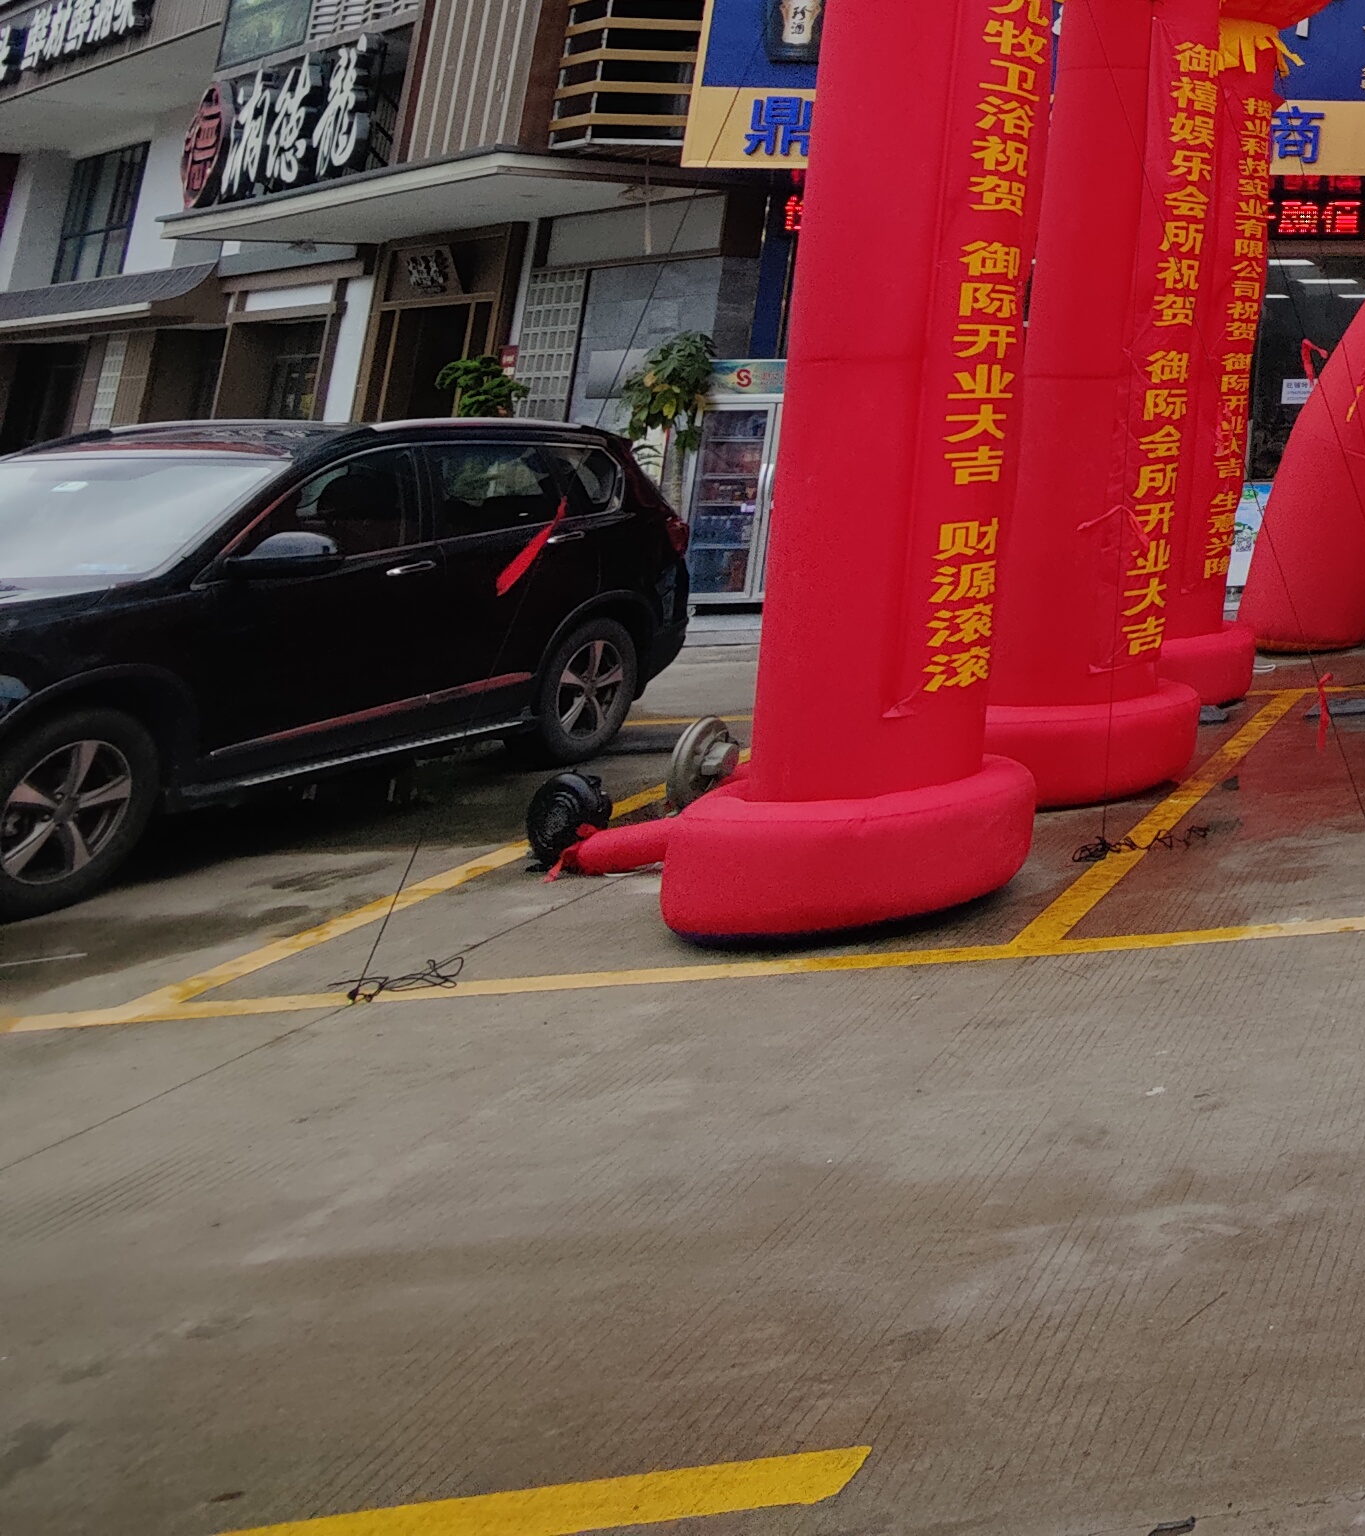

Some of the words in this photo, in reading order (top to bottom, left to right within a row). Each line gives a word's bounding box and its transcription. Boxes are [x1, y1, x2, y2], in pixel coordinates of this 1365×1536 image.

[942, 239, 1021, 487] 御际开业大吉
[923, 518, 1000, 693] 财源滚滚
[1122, 349, 1190, 658] 御际会所开业大吉
